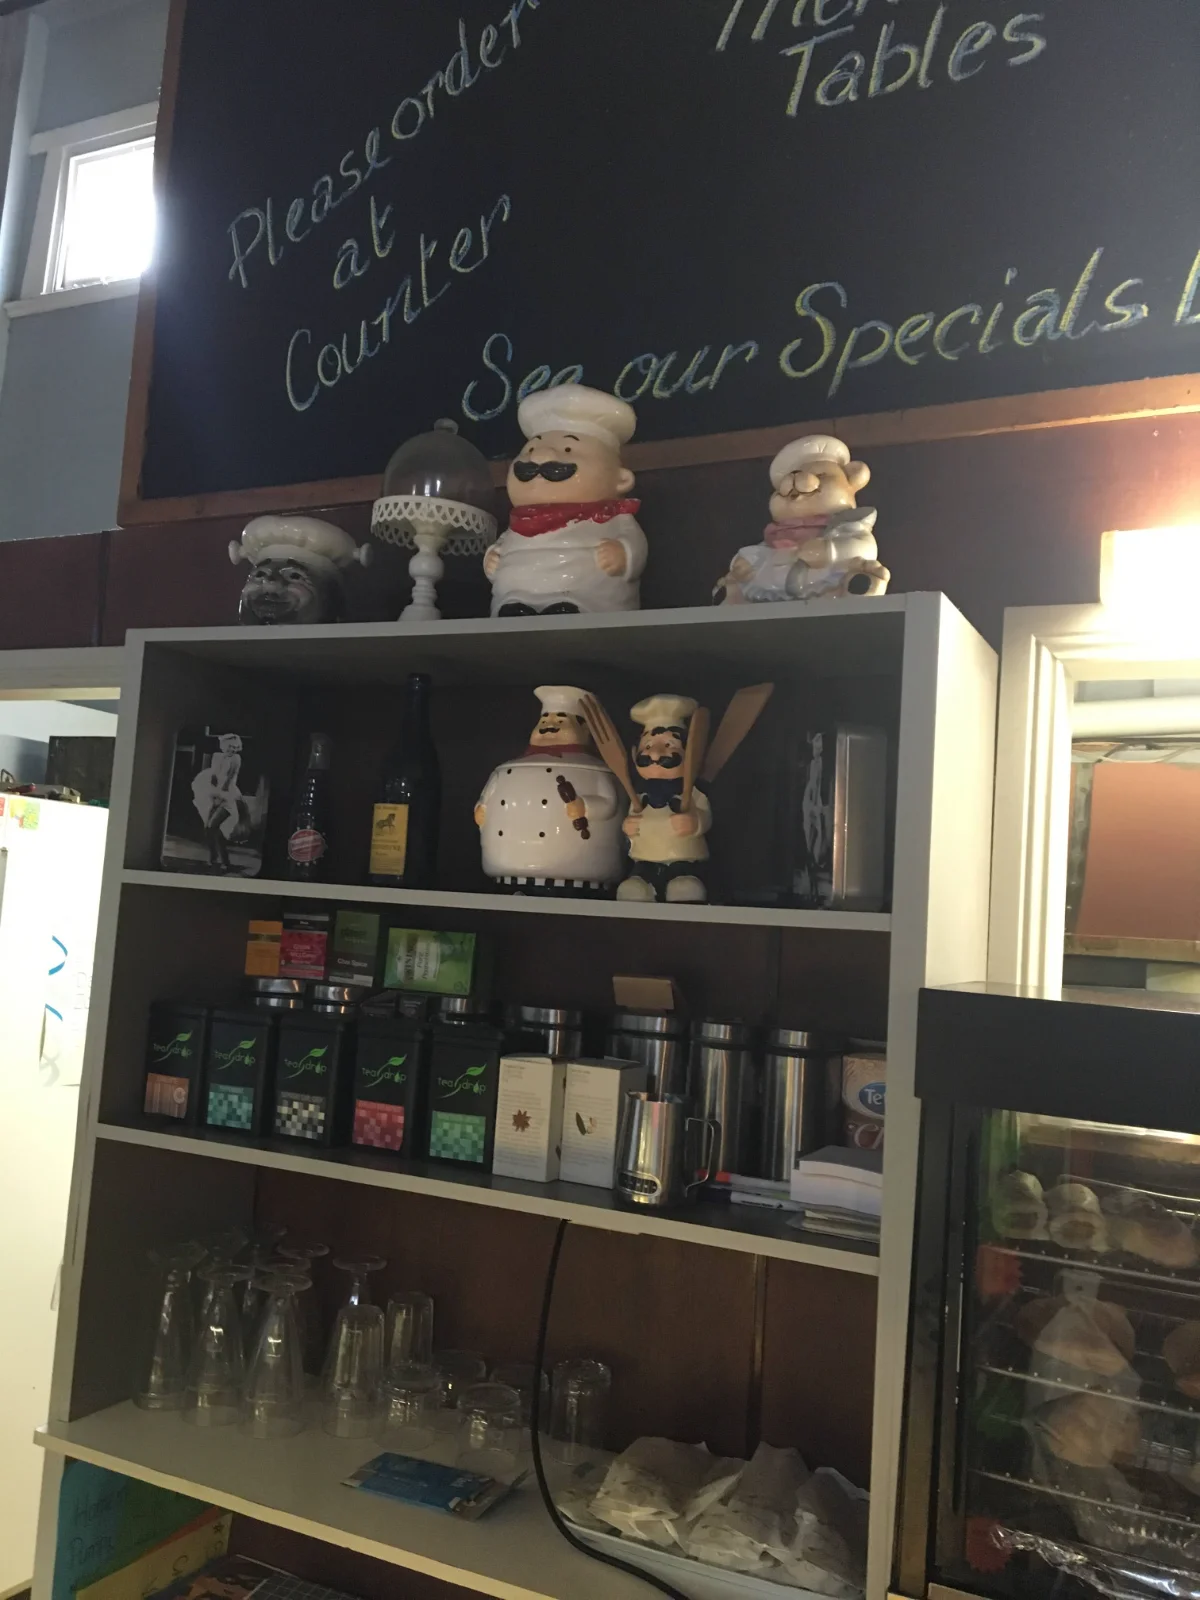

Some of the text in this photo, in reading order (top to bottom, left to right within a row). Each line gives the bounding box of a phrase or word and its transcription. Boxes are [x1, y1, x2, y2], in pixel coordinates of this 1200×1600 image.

[779, 3, 1047, 117] Tables
[227, 0, 541, 289] Please order
[286, 193, 512, 412] Counter
[333, 195, 396, 290] at
[461, 332, 584, 421] See
[613, 340, 760, 402] our
[779, 246, 1149, 399] Specials
[864, 1088, 886, 1105] Te
